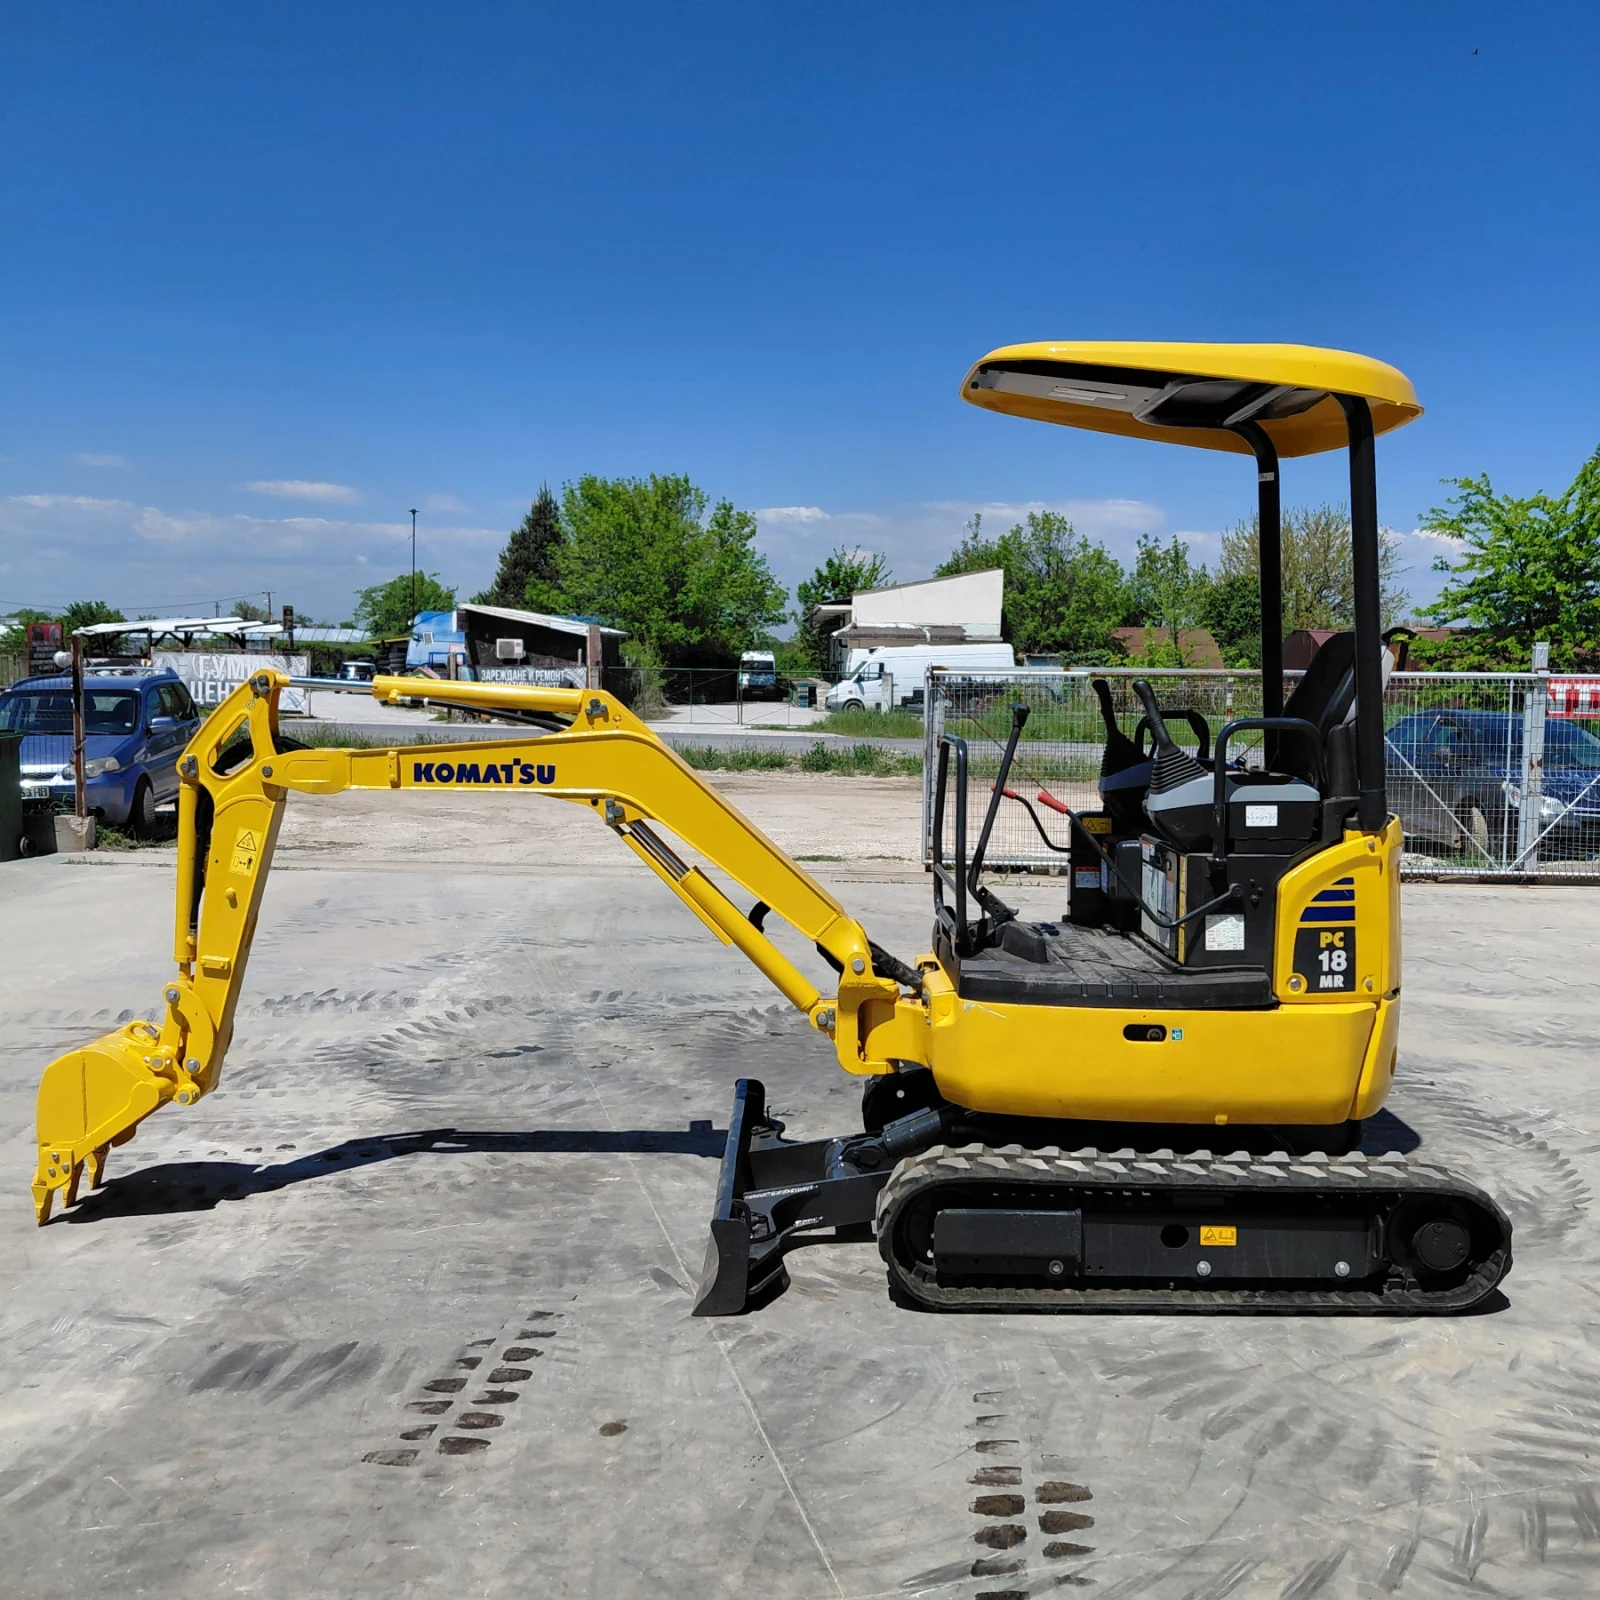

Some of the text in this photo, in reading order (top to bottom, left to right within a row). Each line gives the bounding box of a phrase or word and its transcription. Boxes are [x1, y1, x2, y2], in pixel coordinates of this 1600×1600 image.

[481, 669, 565, 682] ЗАРЕЖДАНЕ И РЕМОНТ
[413, 758, 556, 784] KOMATSU
[1319, 931, 1345, 948] PC
[1318, 949, 1348, 972] 18
[1319, 974, 1345, 988] MR
